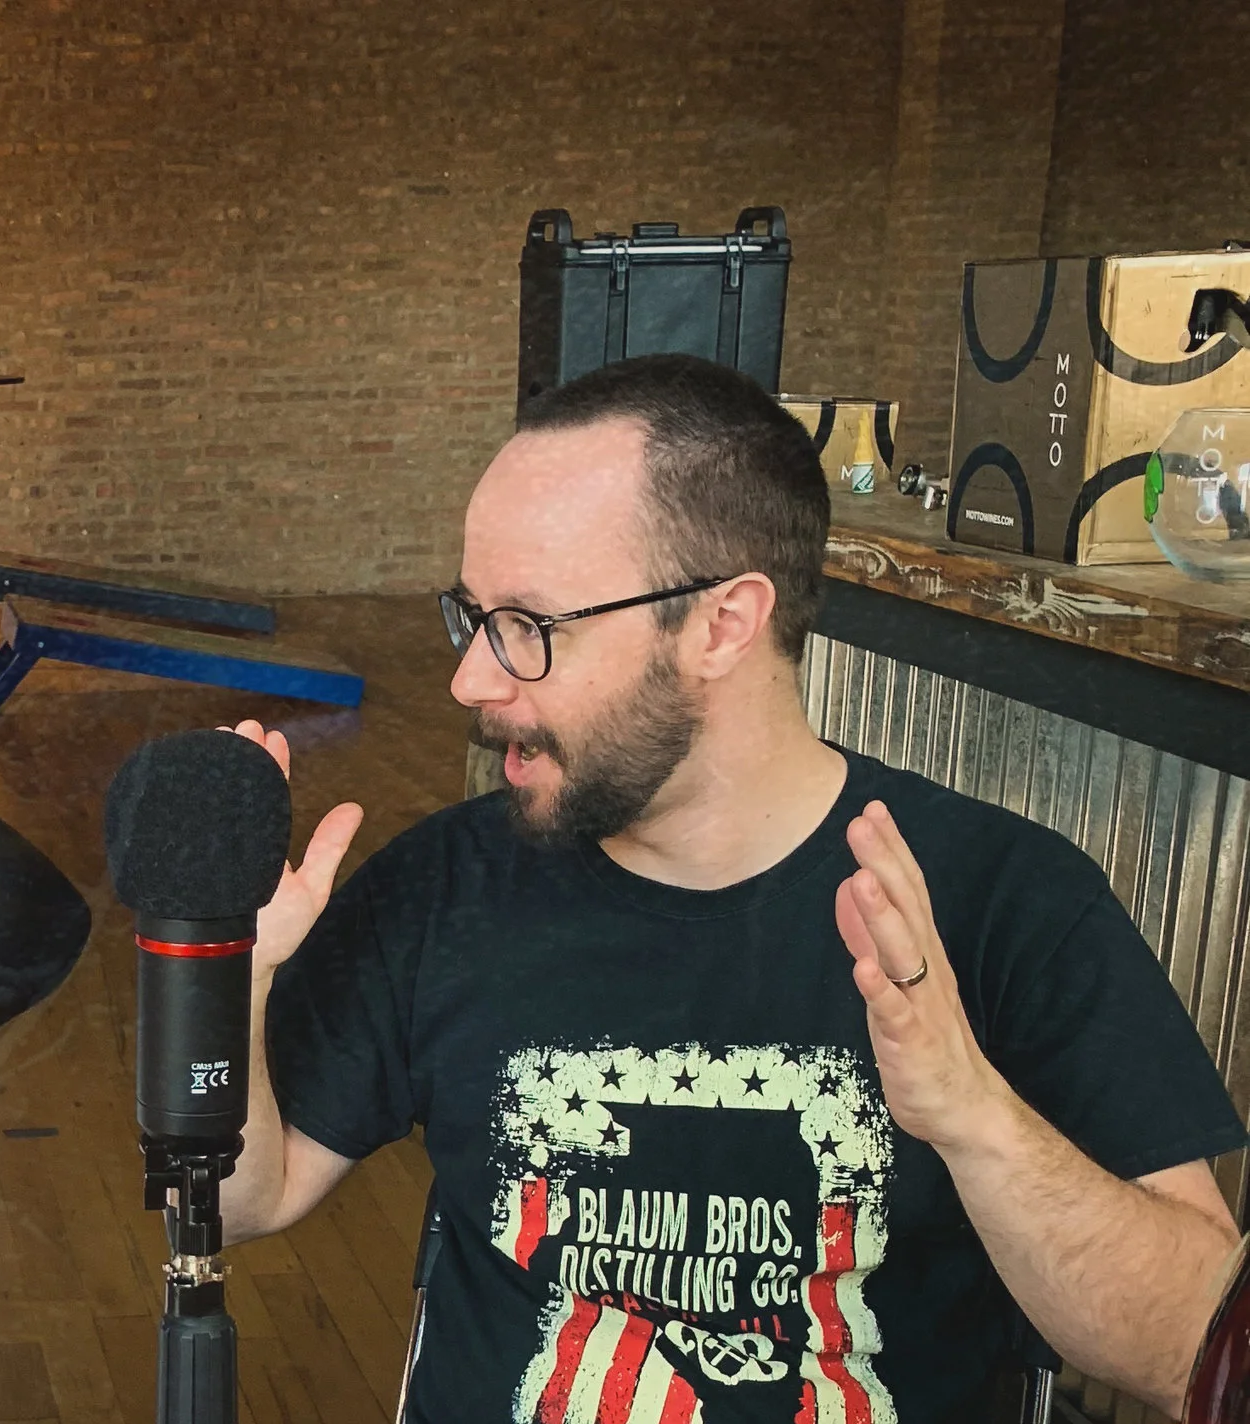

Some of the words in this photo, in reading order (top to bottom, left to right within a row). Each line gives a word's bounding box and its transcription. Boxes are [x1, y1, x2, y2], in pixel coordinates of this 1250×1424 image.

[1049, 353, 1070, 467] MOTTO
[577, 1187, 688, 1251] BLAUM
[705, 1194, 802, 1259] BROS.
[559, 1245, 737, 1313] DISTILLING
[751, 1260, 799, 1308] CO.
